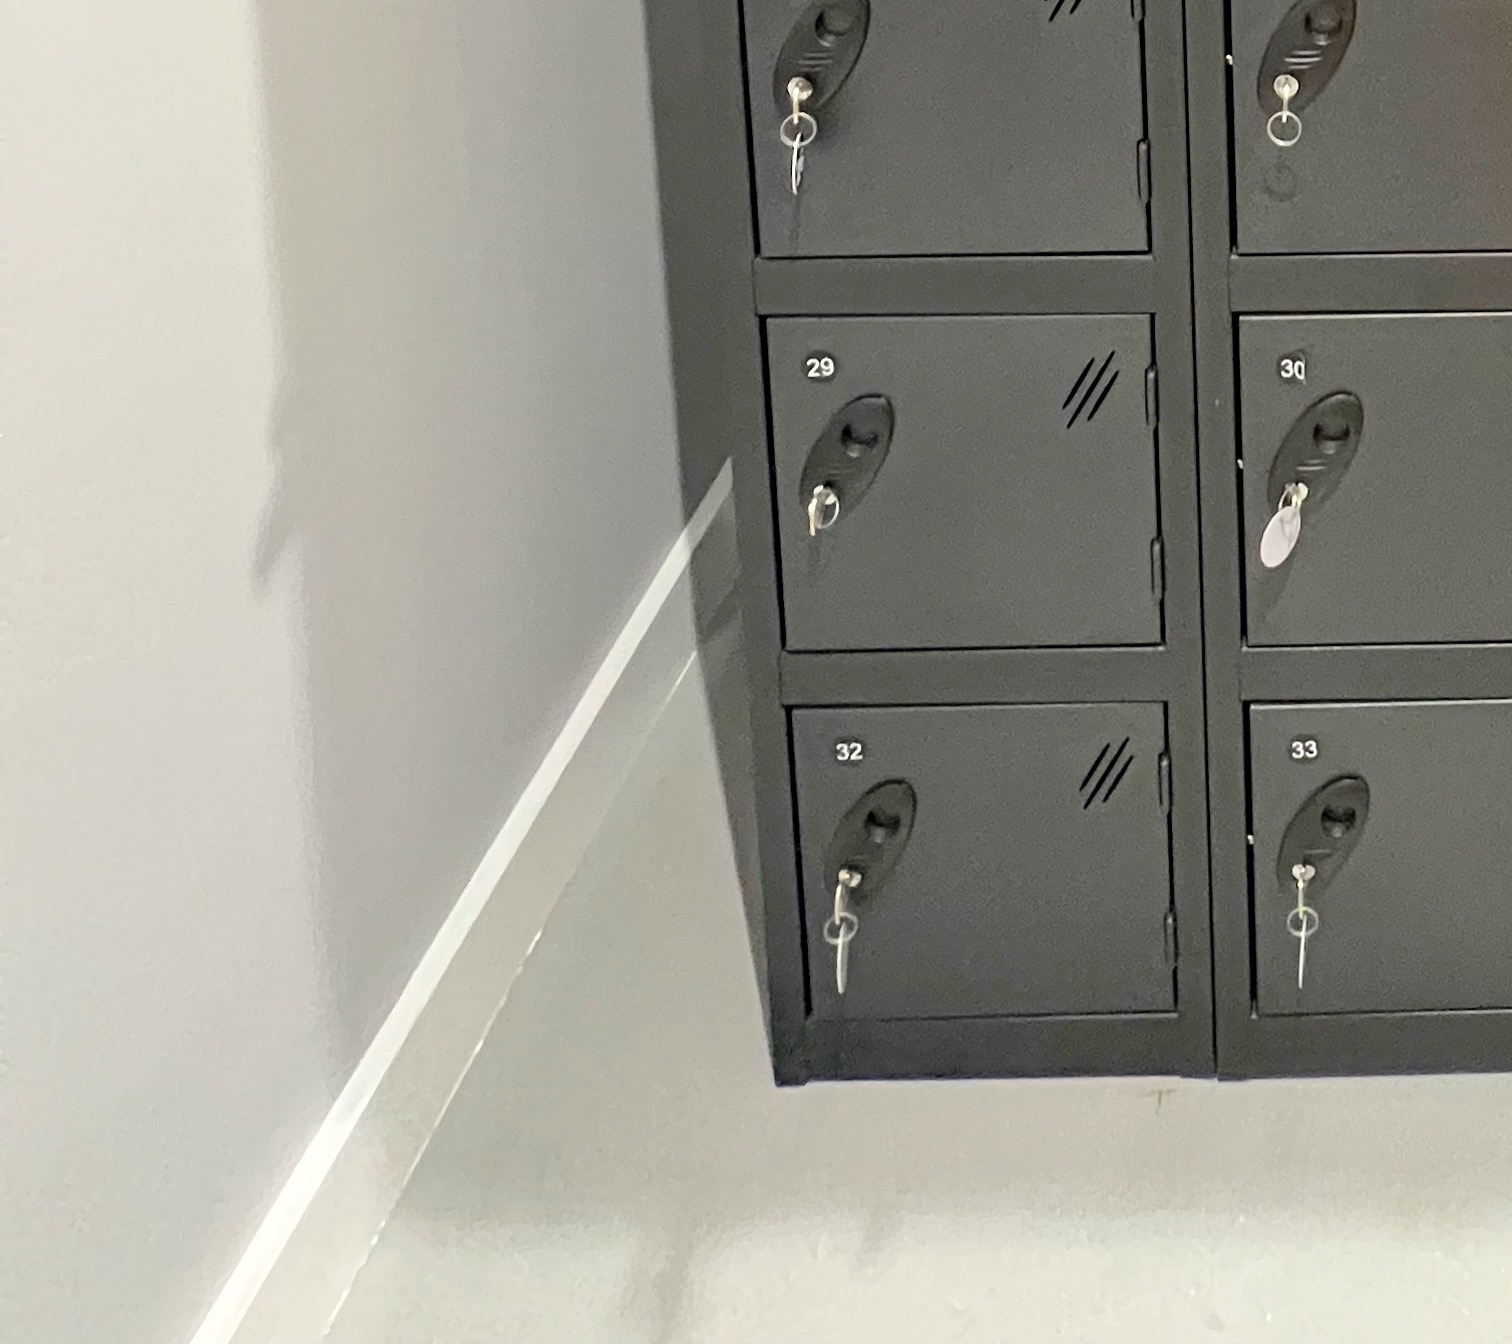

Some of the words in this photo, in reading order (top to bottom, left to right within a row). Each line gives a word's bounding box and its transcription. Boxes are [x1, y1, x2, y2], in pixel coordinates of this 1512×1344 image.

[806, 357, 835, 378] 29
[1280, 358, 1305, 381] 30
[836, 742, 863, 761] 32
[1291, 740, 1318, 759] 33
